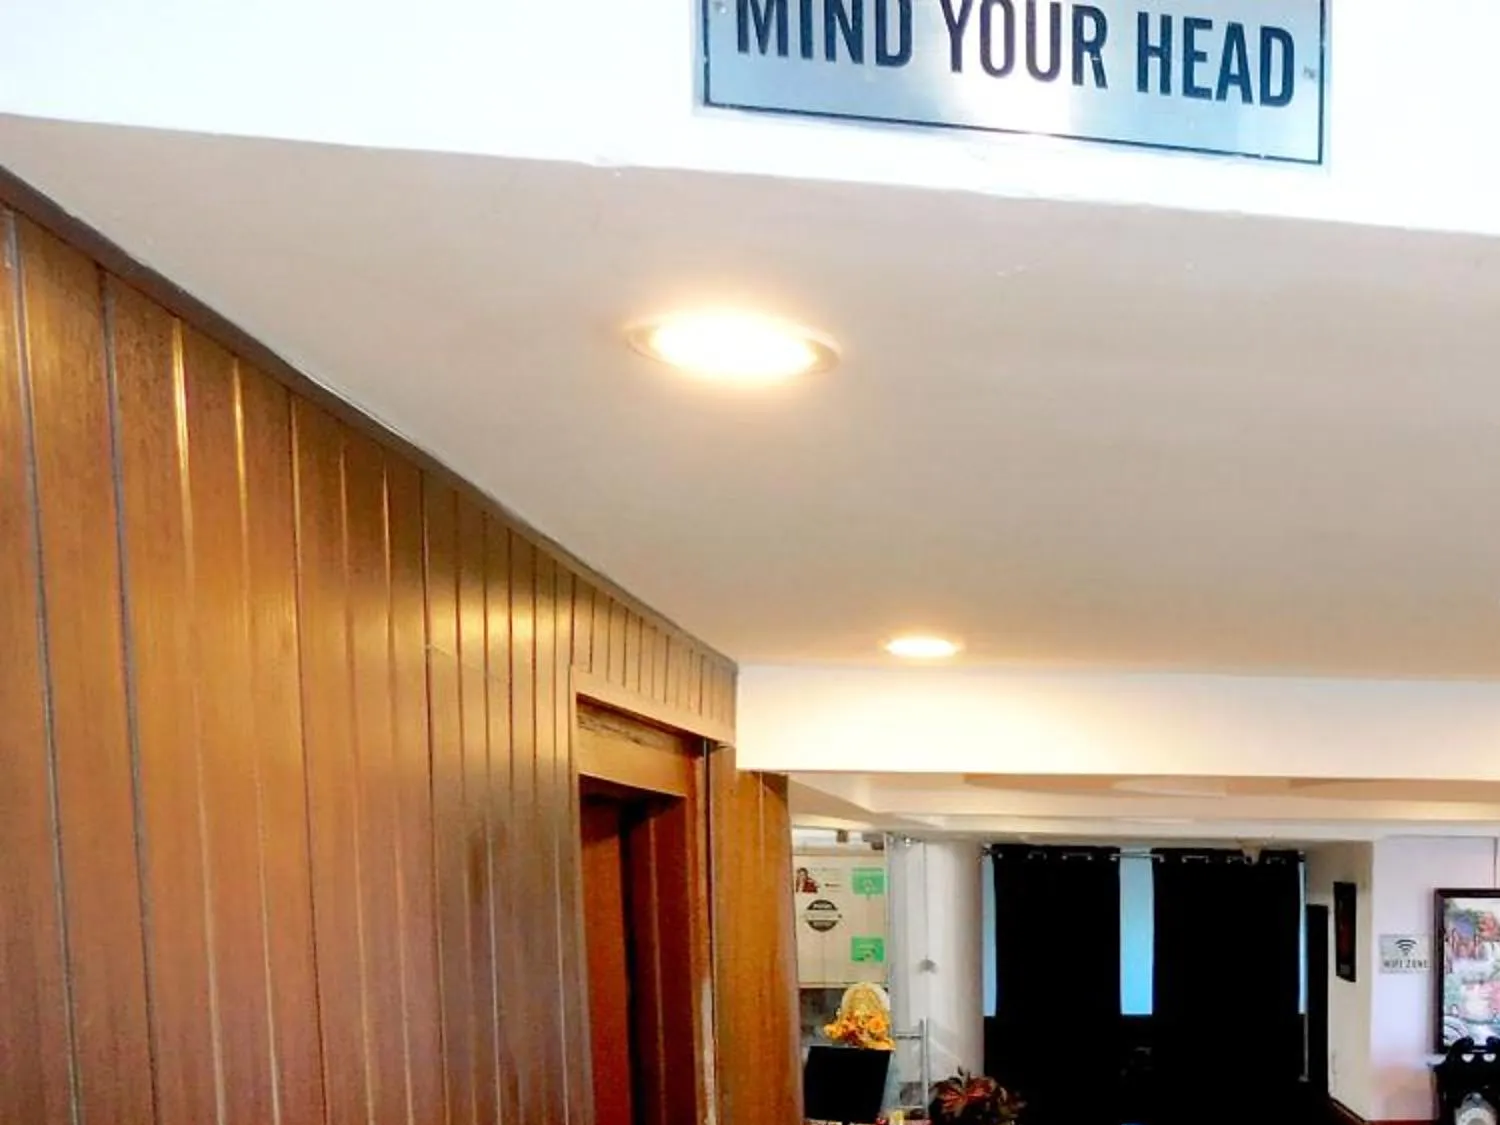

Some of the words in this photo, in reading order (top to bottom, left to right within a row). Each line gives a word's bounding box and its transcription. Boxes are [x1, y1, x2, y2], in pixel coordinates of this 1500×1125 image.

[736, 0, 911, 67] MIND
[939, 0, 1108, 89] YOUR
[1137, 11, 1295, 108] HEAD
